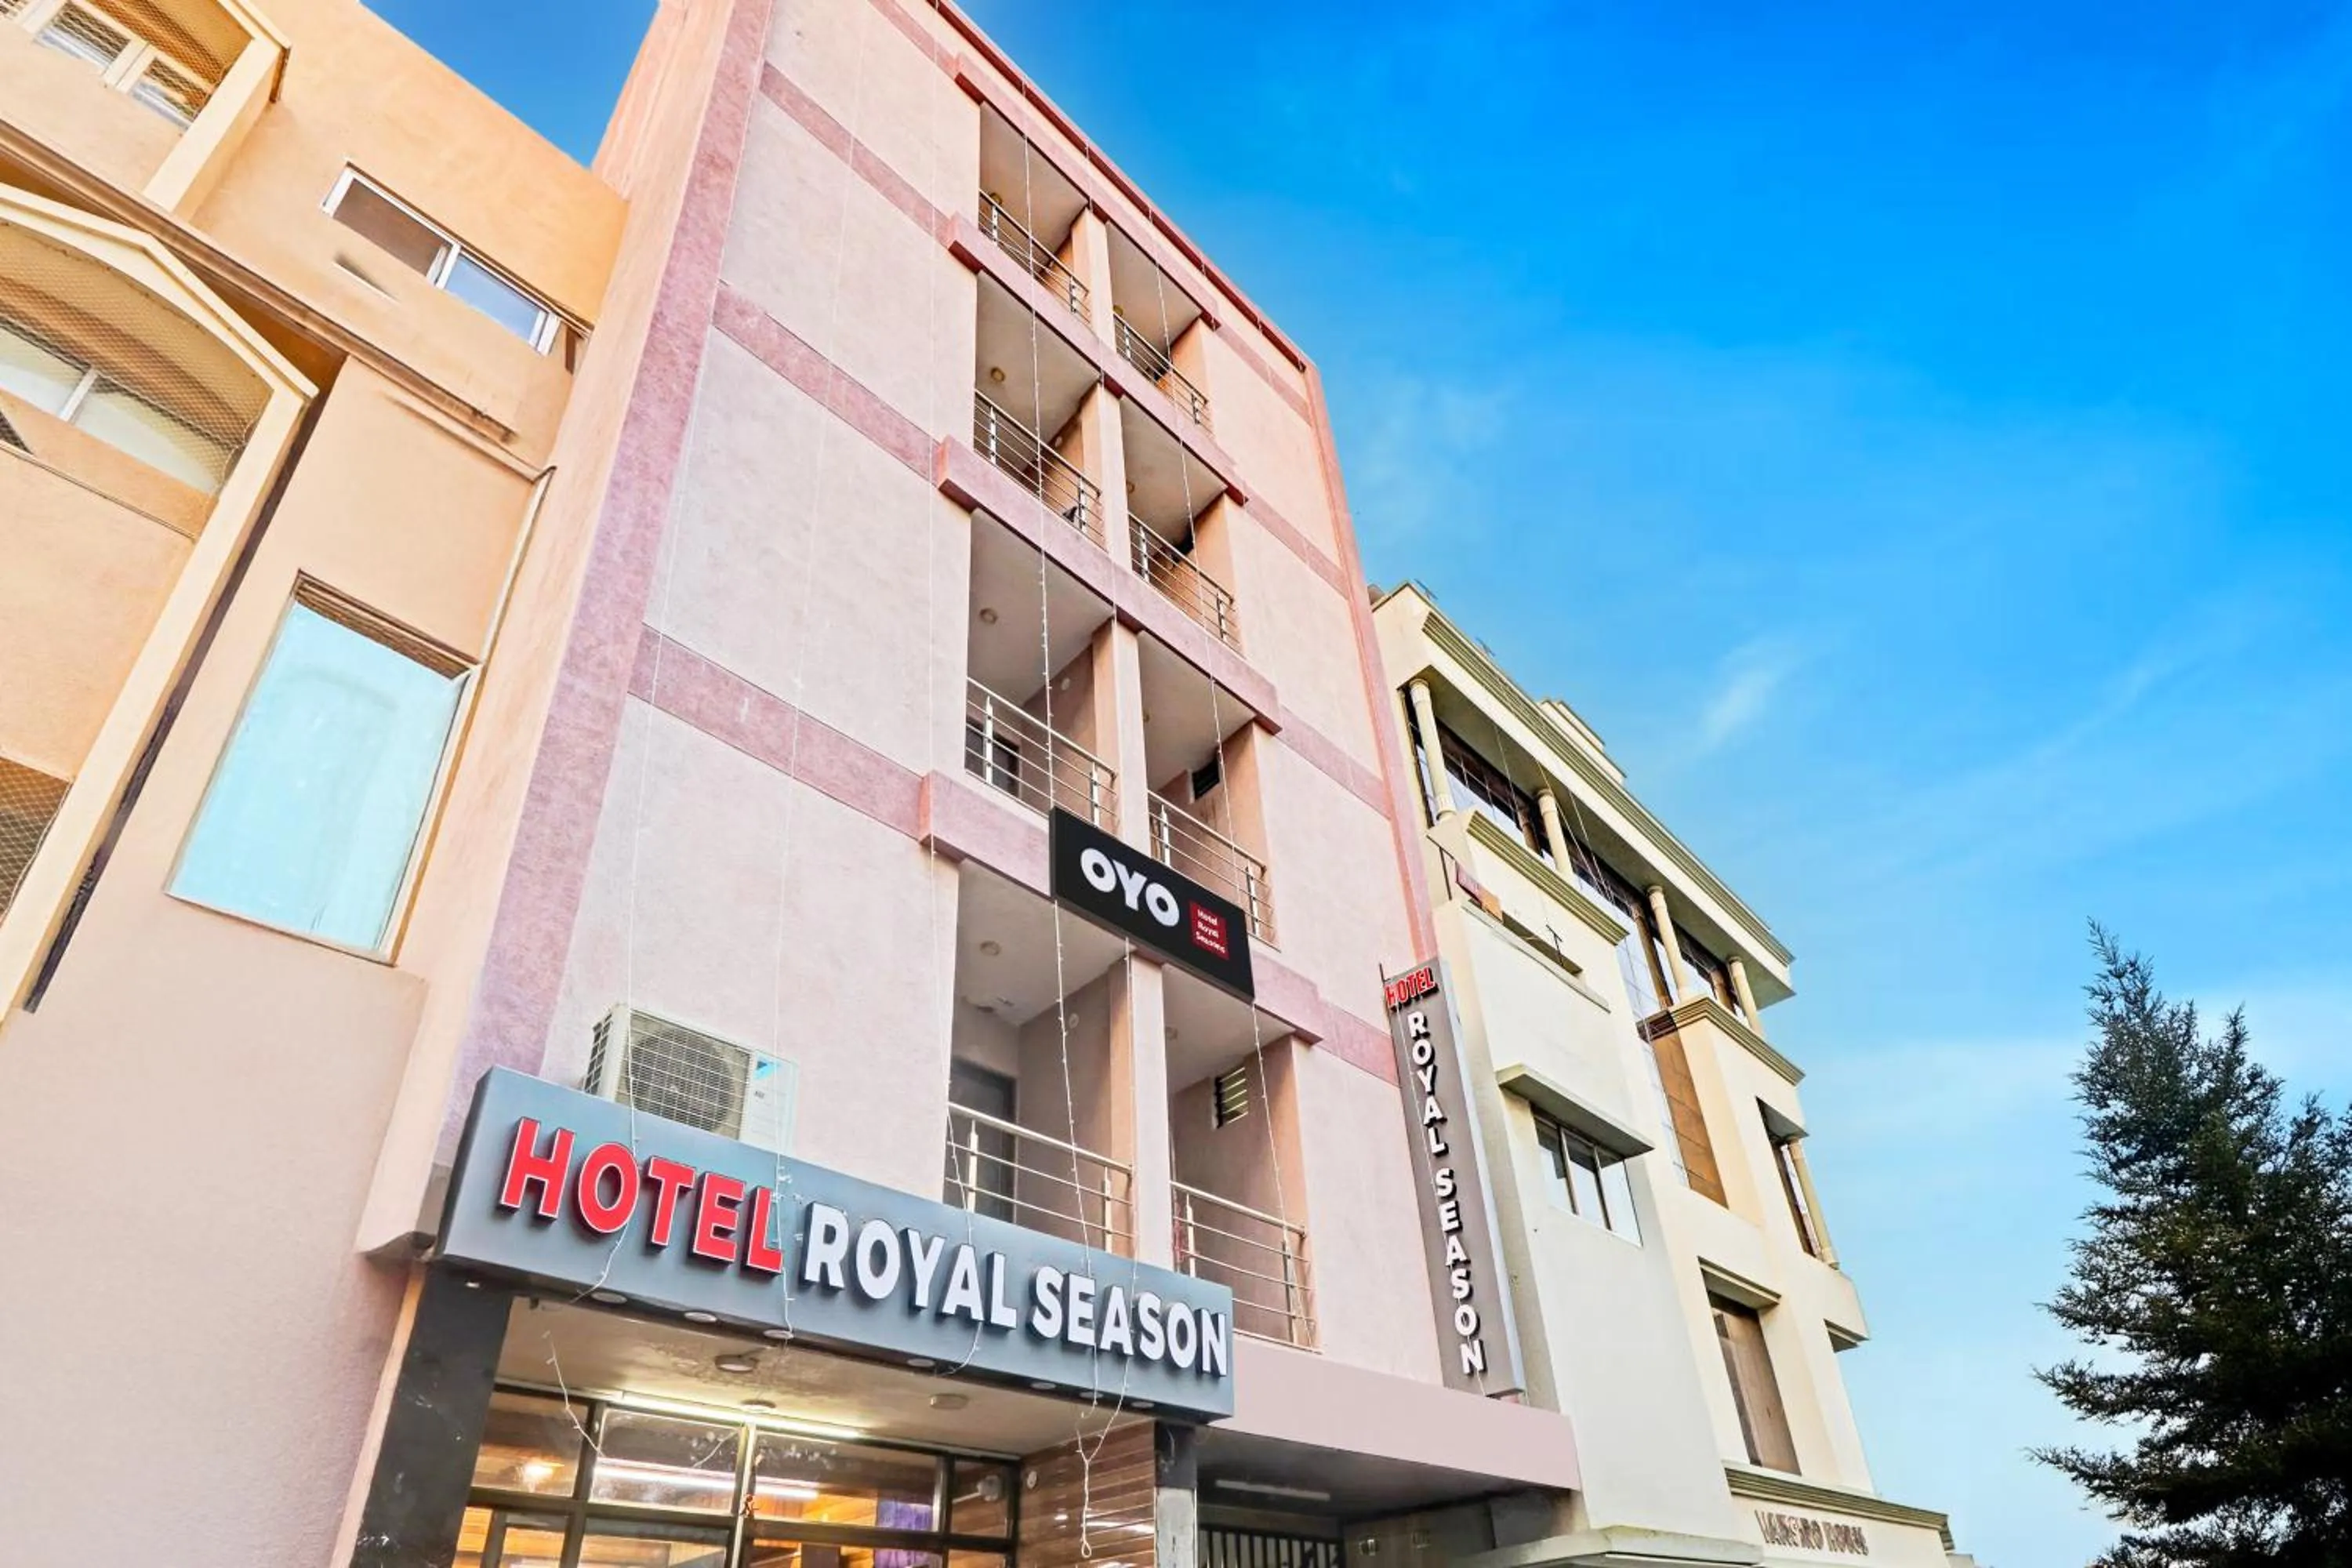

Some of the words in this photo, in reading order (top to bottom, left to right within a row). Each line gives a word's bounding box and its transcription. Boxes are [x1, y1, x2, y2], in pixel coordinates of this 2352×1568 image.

[1080, 848, 1180, 927] OYO
[1384, 966, 1436, 1008] HOTEL
[500, 1116, 783, 1275] HOTEL
[803, 1201, 1018, 1331] ROYAL
[1029, 1265, 1228, 1377] SEASON
[1407, 1011, 1446, 1155] ROYAL
[1436, 1167, 1486, 1375] SEASON
